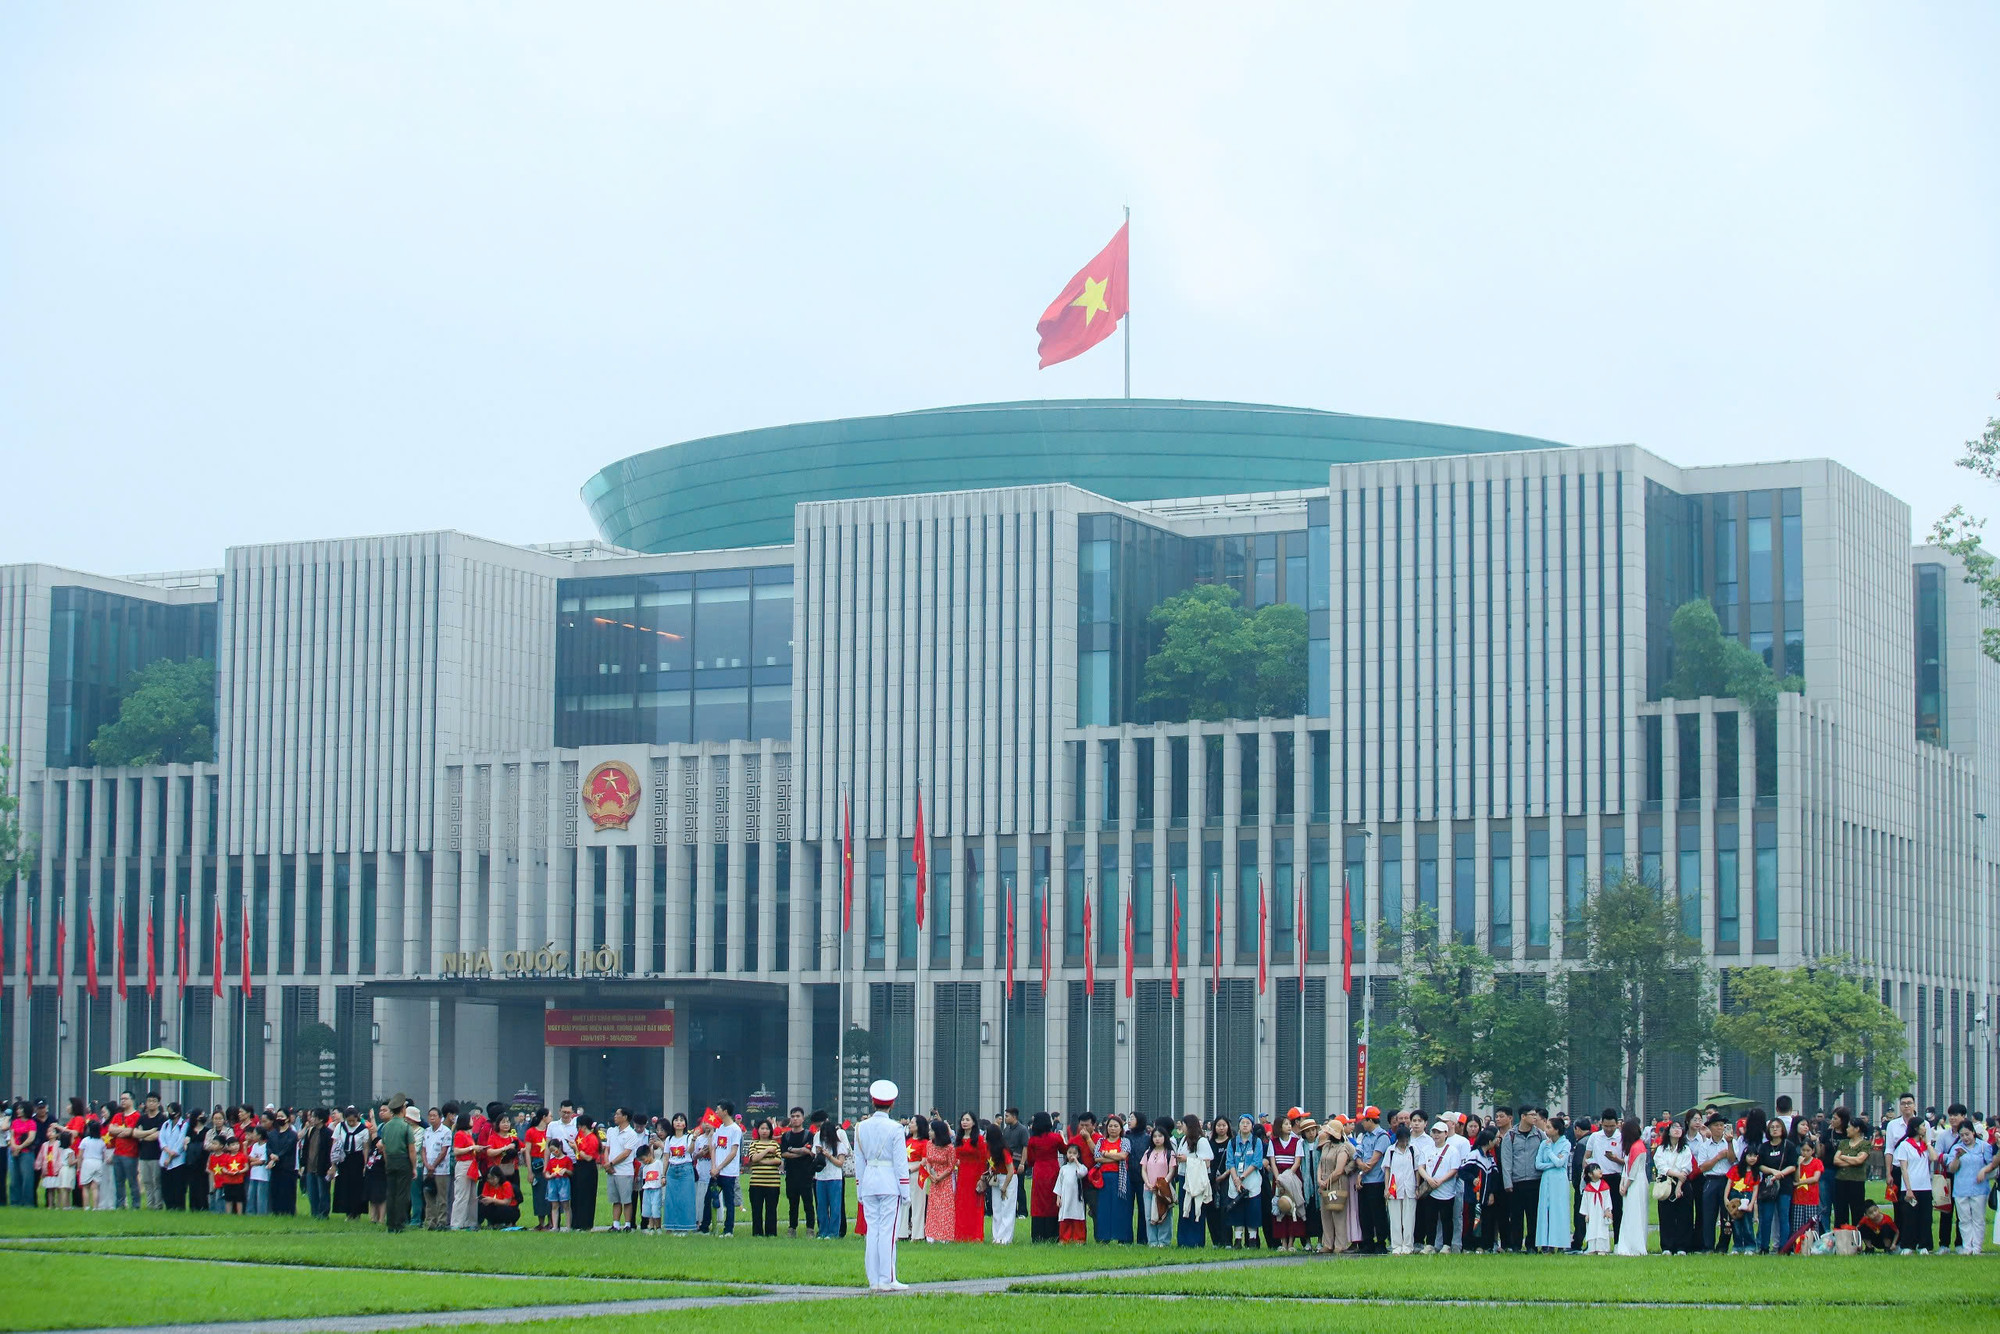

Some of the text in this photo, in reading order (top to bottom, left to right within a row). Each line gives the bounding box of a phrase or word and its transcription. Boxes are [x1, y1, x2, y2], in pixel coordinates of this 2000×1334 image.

[442, 940, 621, 975] NHÀ QUỐC HỘI
